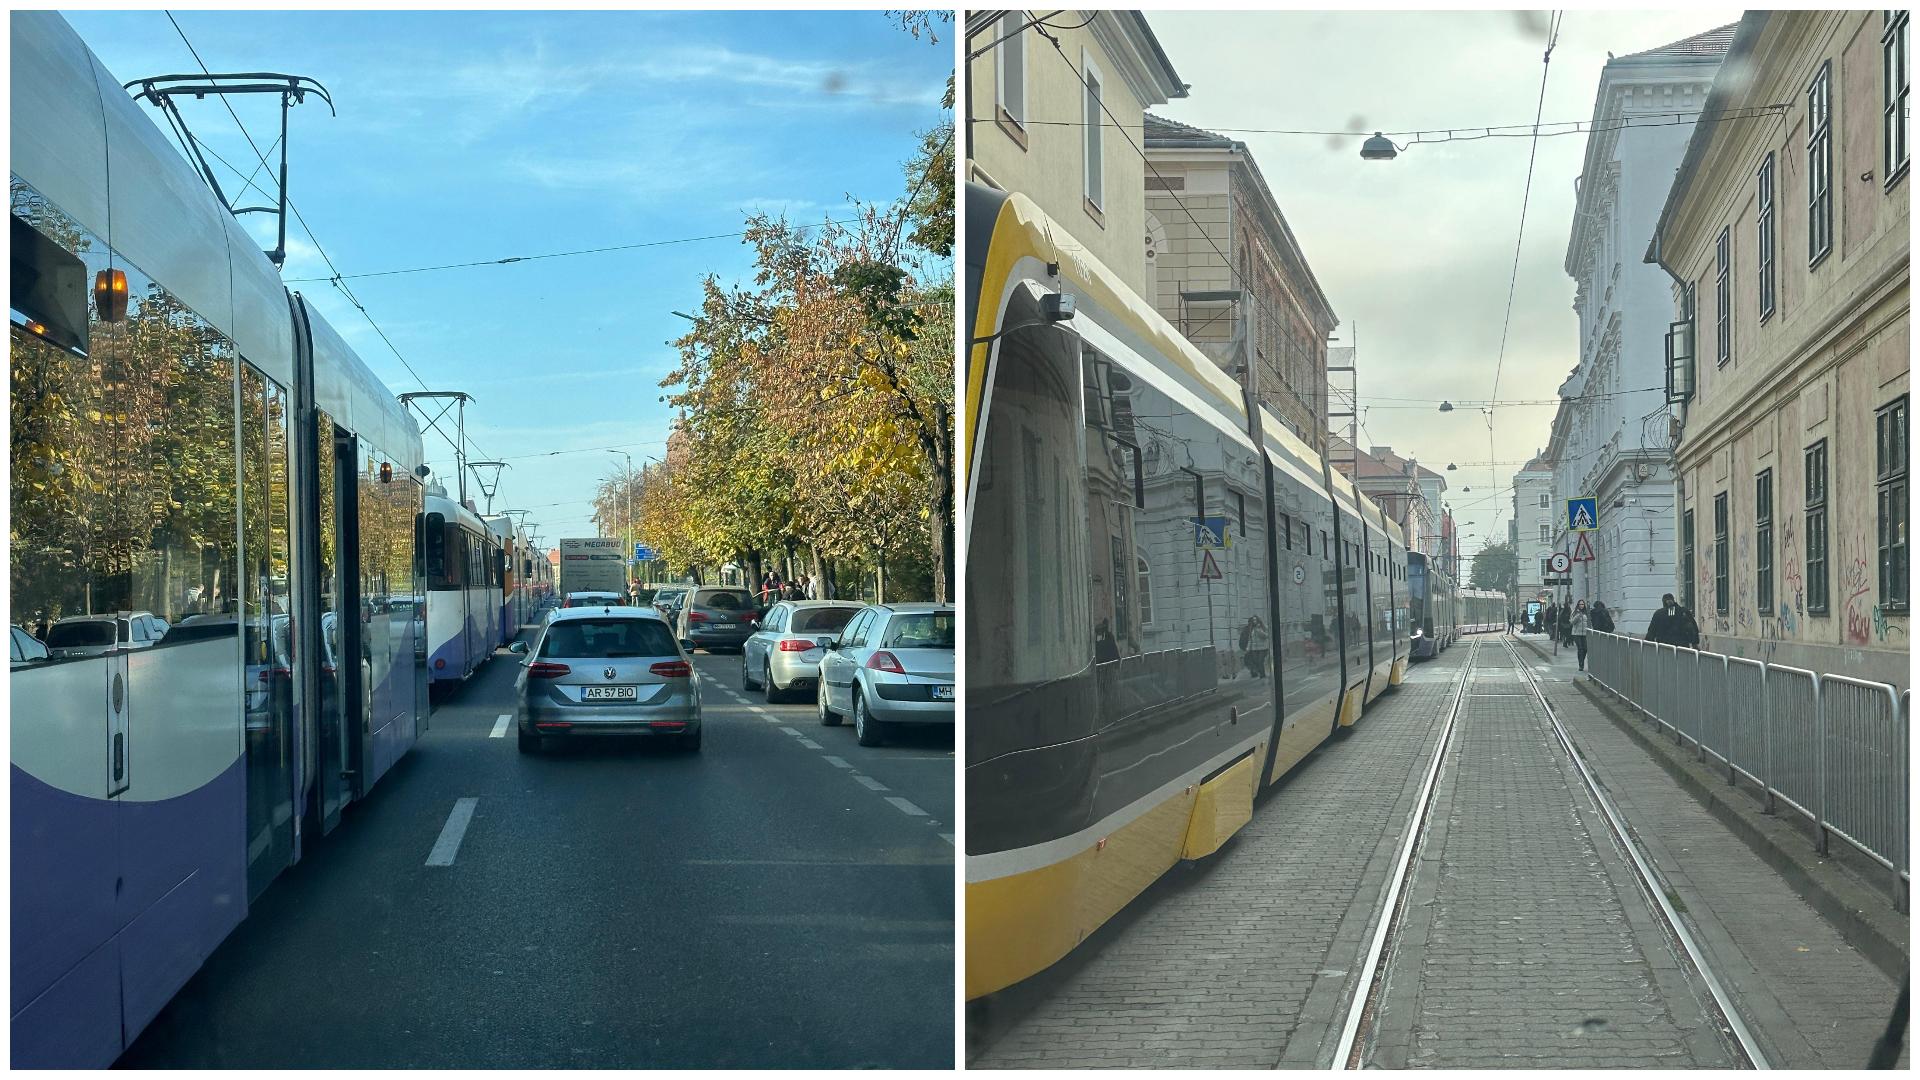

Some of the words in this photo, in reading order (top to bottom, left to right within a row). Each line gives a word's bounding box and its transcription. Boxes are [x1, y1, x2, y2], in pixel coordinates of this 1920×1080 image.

[1557, 558, 1563, 568] 5
[587, 688, 602, 698] AR
[604, 687, 616, 698] 57
[617, 687, 634, 697] BIO
[938, 687, 952, 696] MH
